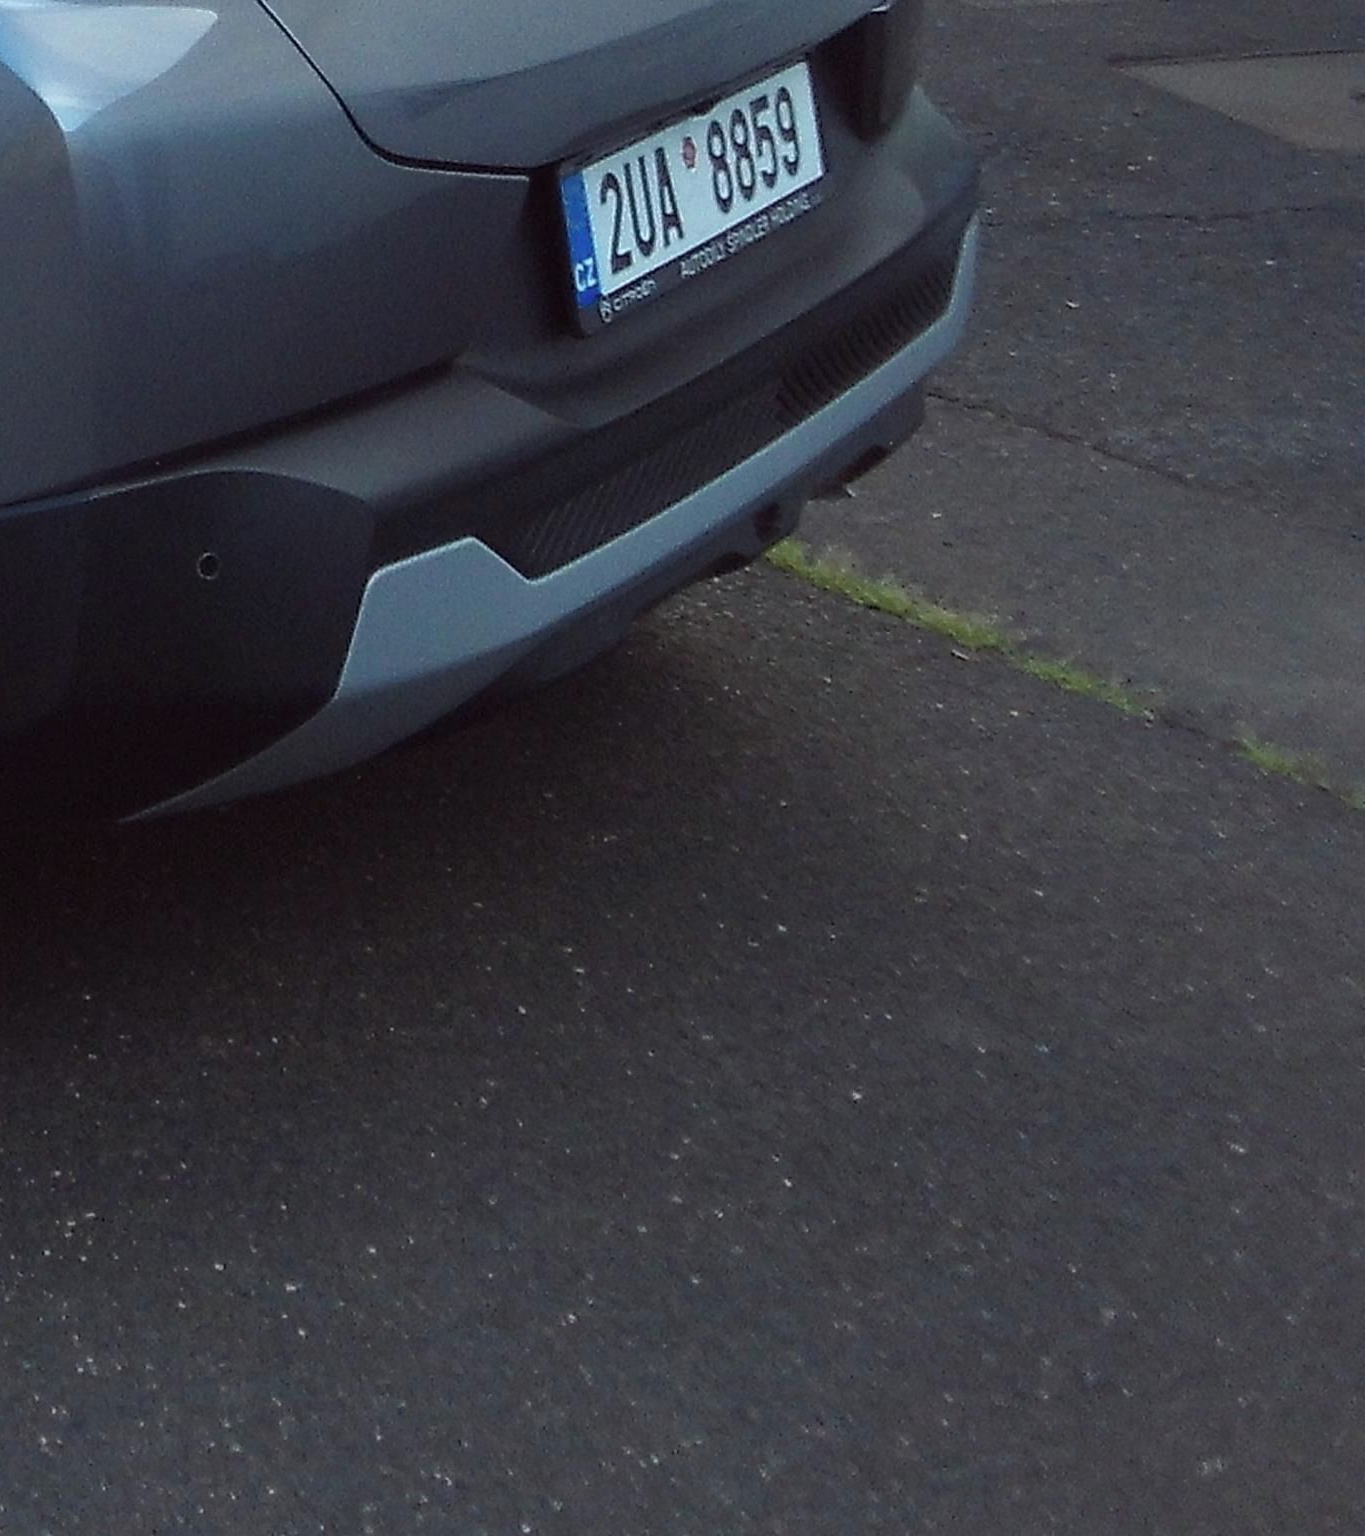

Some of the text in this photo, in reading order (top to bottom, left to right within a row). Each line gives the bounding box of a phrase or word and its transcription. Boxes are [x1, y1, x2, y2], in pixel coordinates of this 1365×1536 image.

[600, 86, 800, 275] 2UA 8859
[574, 257, 598, 292] CZ
